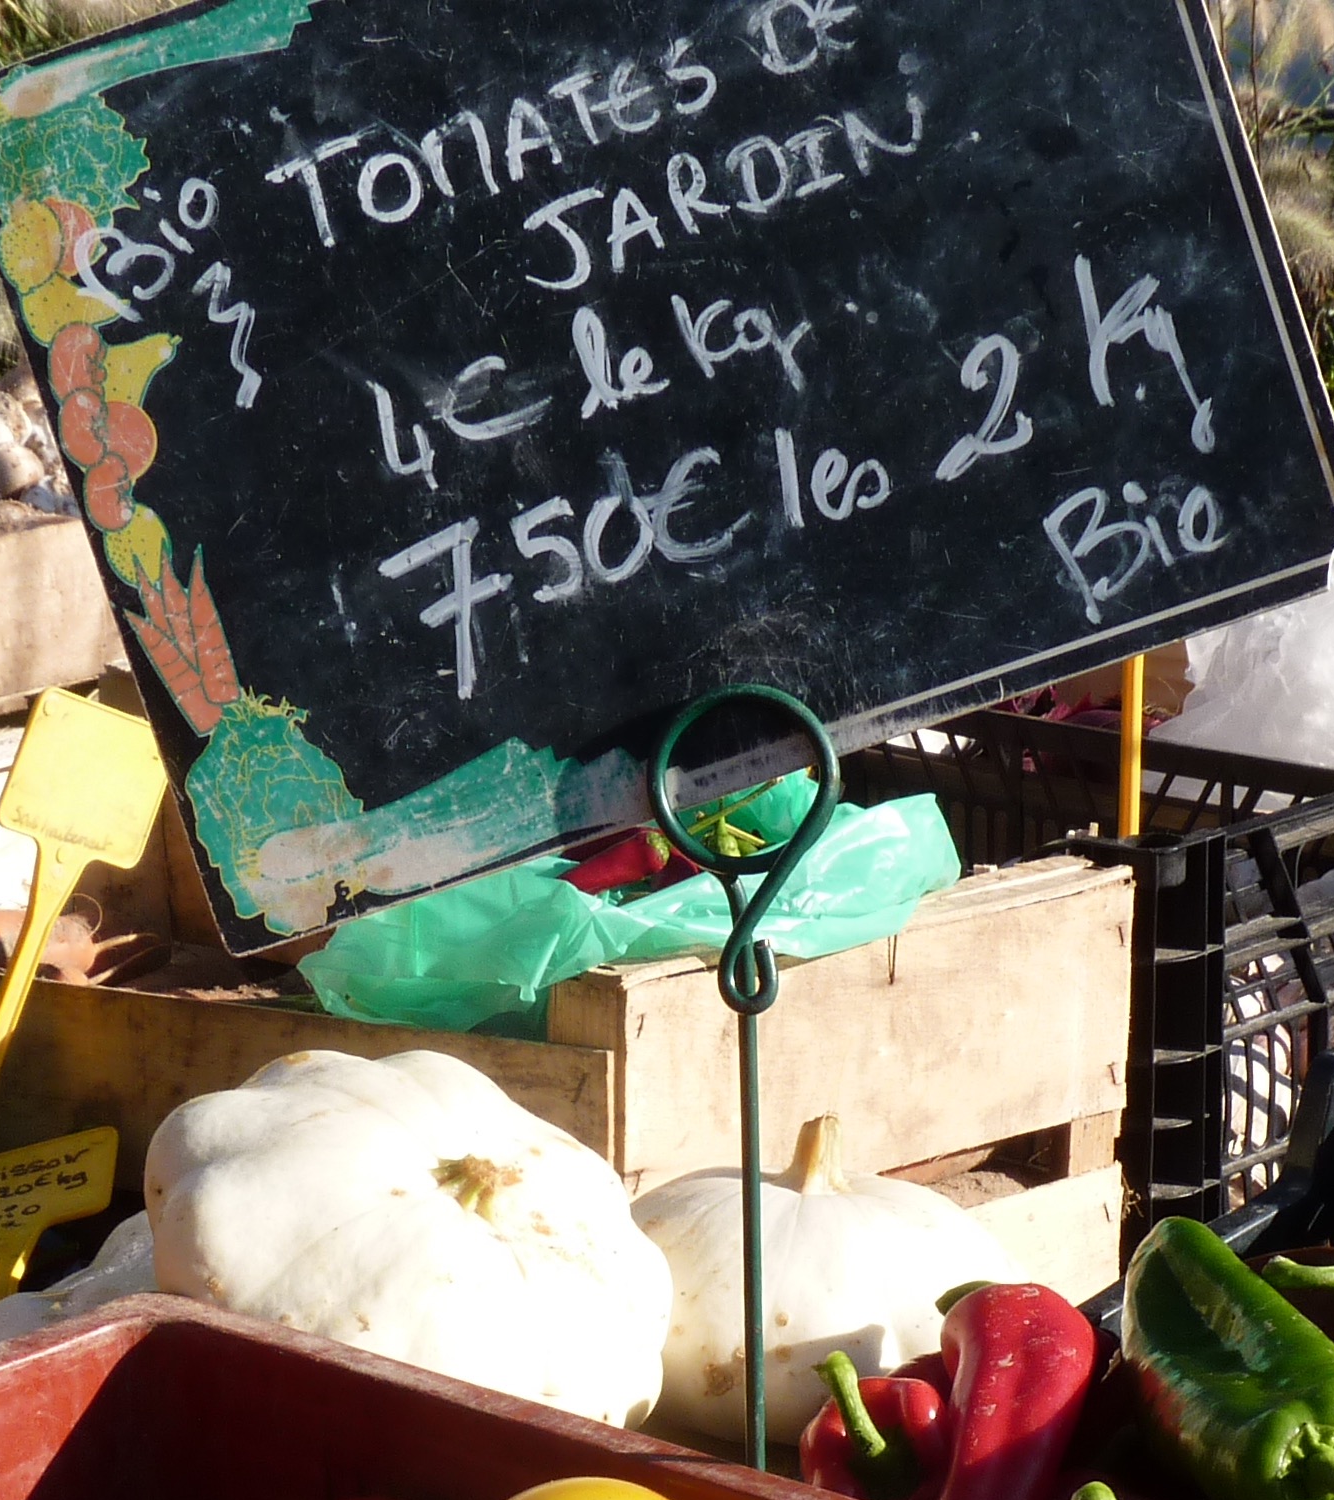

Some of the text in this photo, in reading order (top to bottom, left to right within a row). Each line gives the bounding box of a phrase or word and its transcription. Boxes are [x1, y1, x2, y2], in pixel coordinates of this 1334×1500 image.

[264, 39, 718, 249] TOMATES
[524, 92, 924, 292] JARDIN
[75, 177, 221, 323] Bio
[572, 304, 670, 420] le
[774, 426, 893, 530] les
[934, 332, 1034, 482] 2
